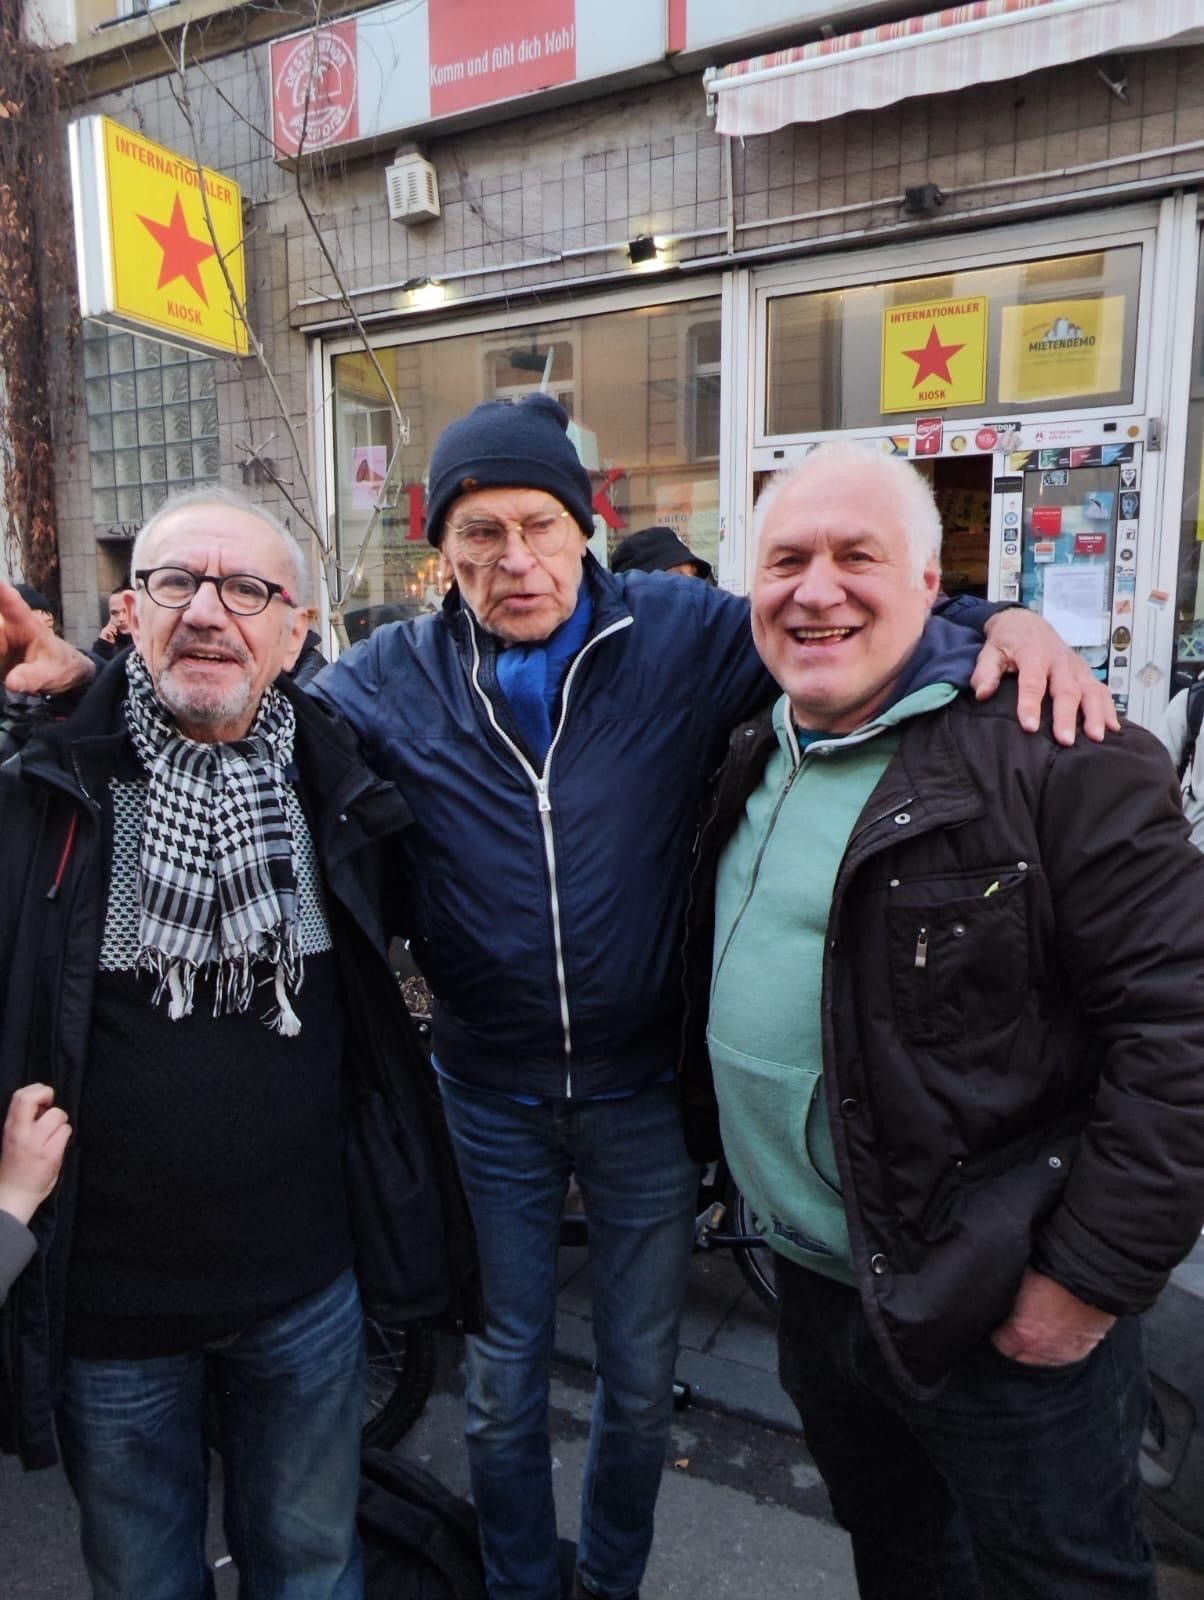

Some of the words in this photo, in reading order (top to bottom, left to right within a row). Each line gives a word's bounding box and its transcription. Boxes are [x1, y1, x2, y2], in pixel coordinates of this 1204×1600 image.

[430, 63, 464, 87] Komm
[467, 50, 489, 77] und
[492, 42, 515, 72] fühl
[518, 34, 542, 63] dich
[115, 134, 232, 206] INTERNATIONALER
[167, 300, 203, 326] KIOSK
[890, 302, 979, 323] INTERNATIONALER
[1028, 336, 1095, 353] MIETENDEMO
[918, 389, 946, 402] KIOSK
